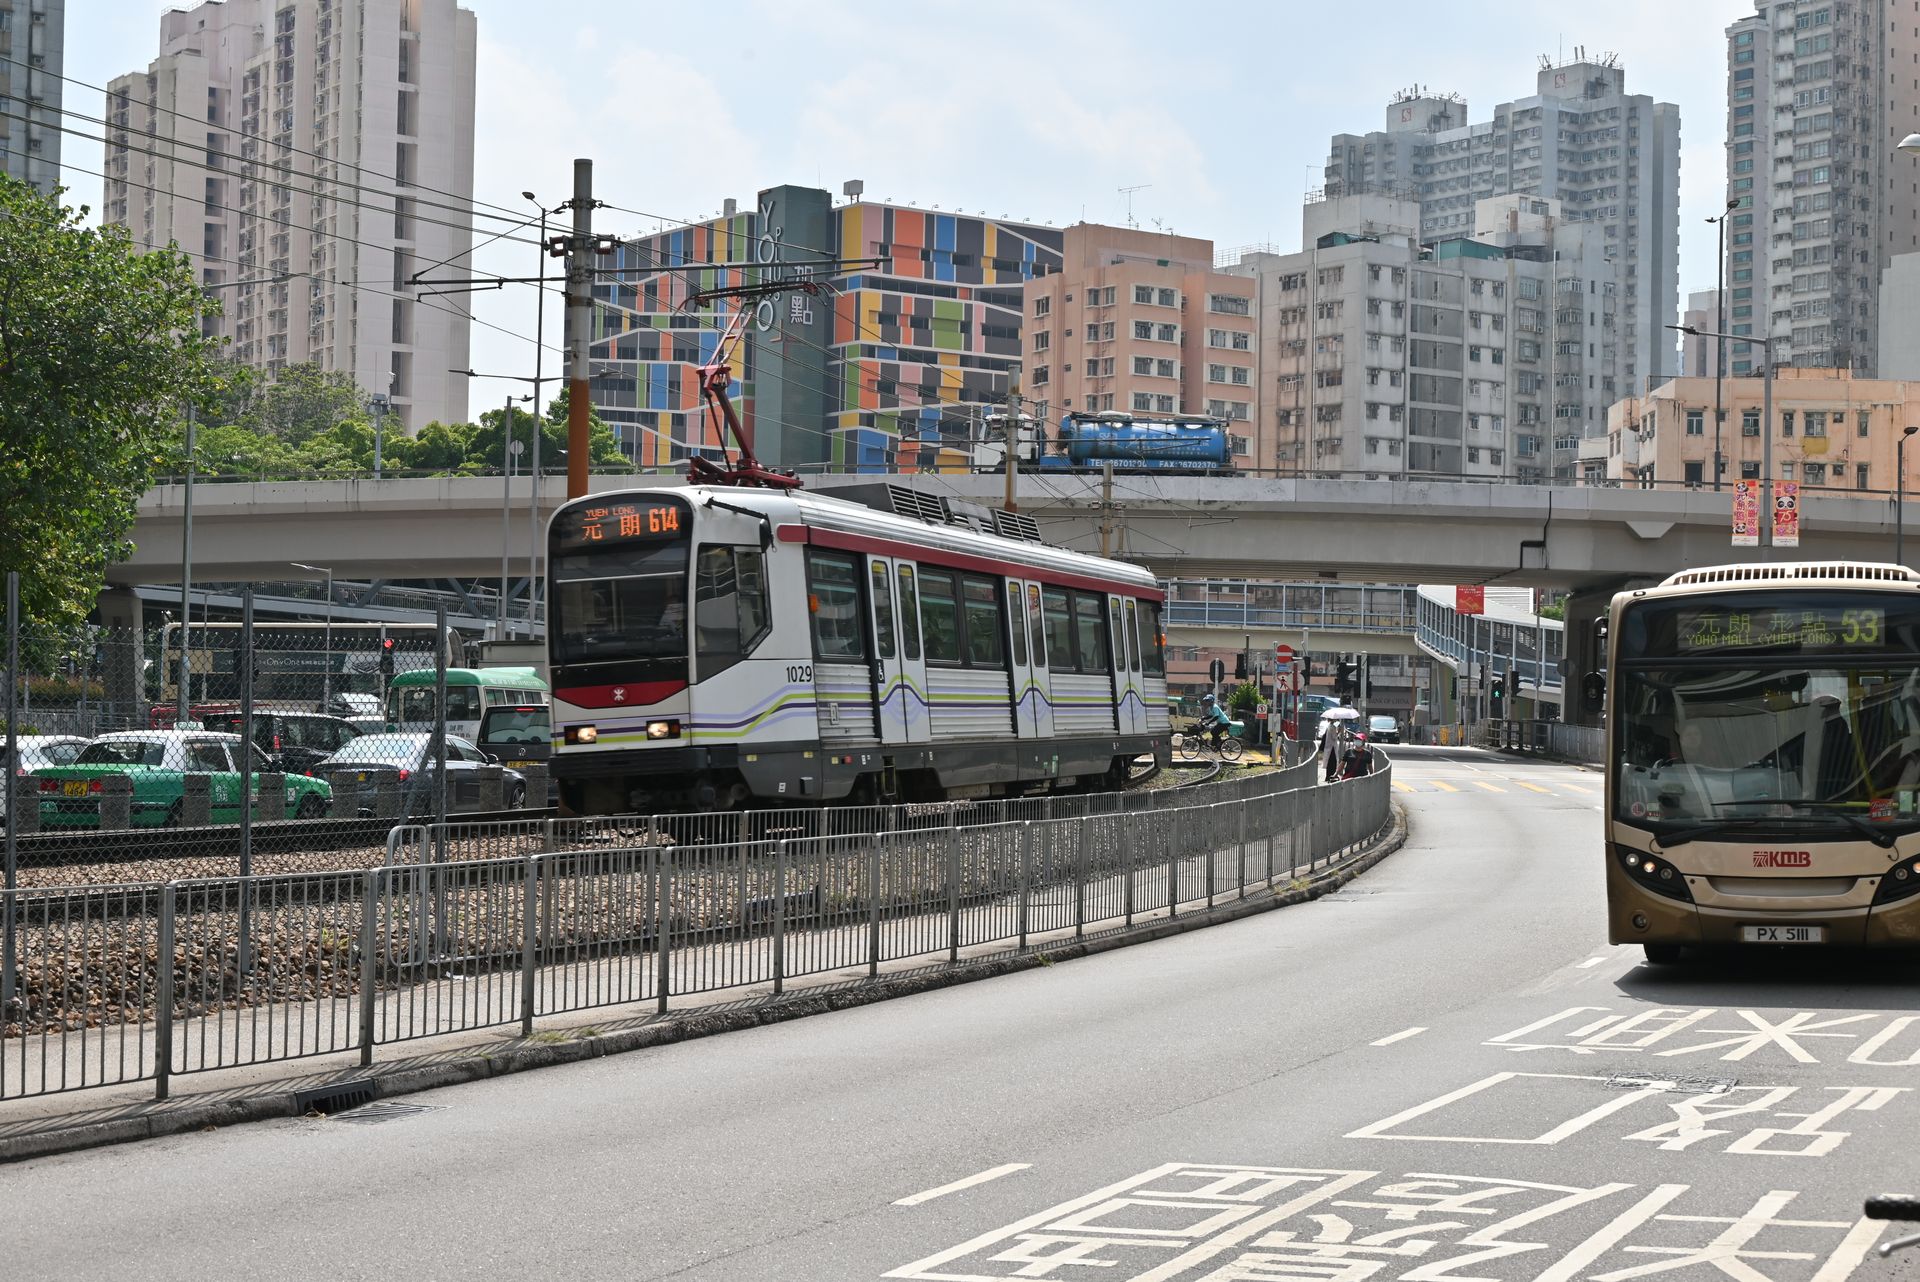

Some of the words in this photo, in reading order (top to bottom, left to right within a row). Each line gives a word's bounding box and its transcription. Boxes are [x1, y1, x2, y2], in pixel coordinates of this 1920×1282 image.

[585, 507, 609, 518] YUEN
[612, 505, 636, 516] LONG
[648, 506, 679, 533] 614
[1779, 511, 1792, 523] 75
[582, 513, 640, 540] 元朗
[1697, 613, 1751, 634] 元朗
[1769, 611, 1827, 634] 形點
[1841, 609, 1879, 644] 53
[1686, 633, 1718, 645] YOHO
[1721, 633, 1753, 645] MALL
[786, 665, 812, 683] 1029
[1769, 851, 1812, 868] KMB
[1757, 927, 1778, 941] PX
[1786, 927, 1809, 941] 5111
